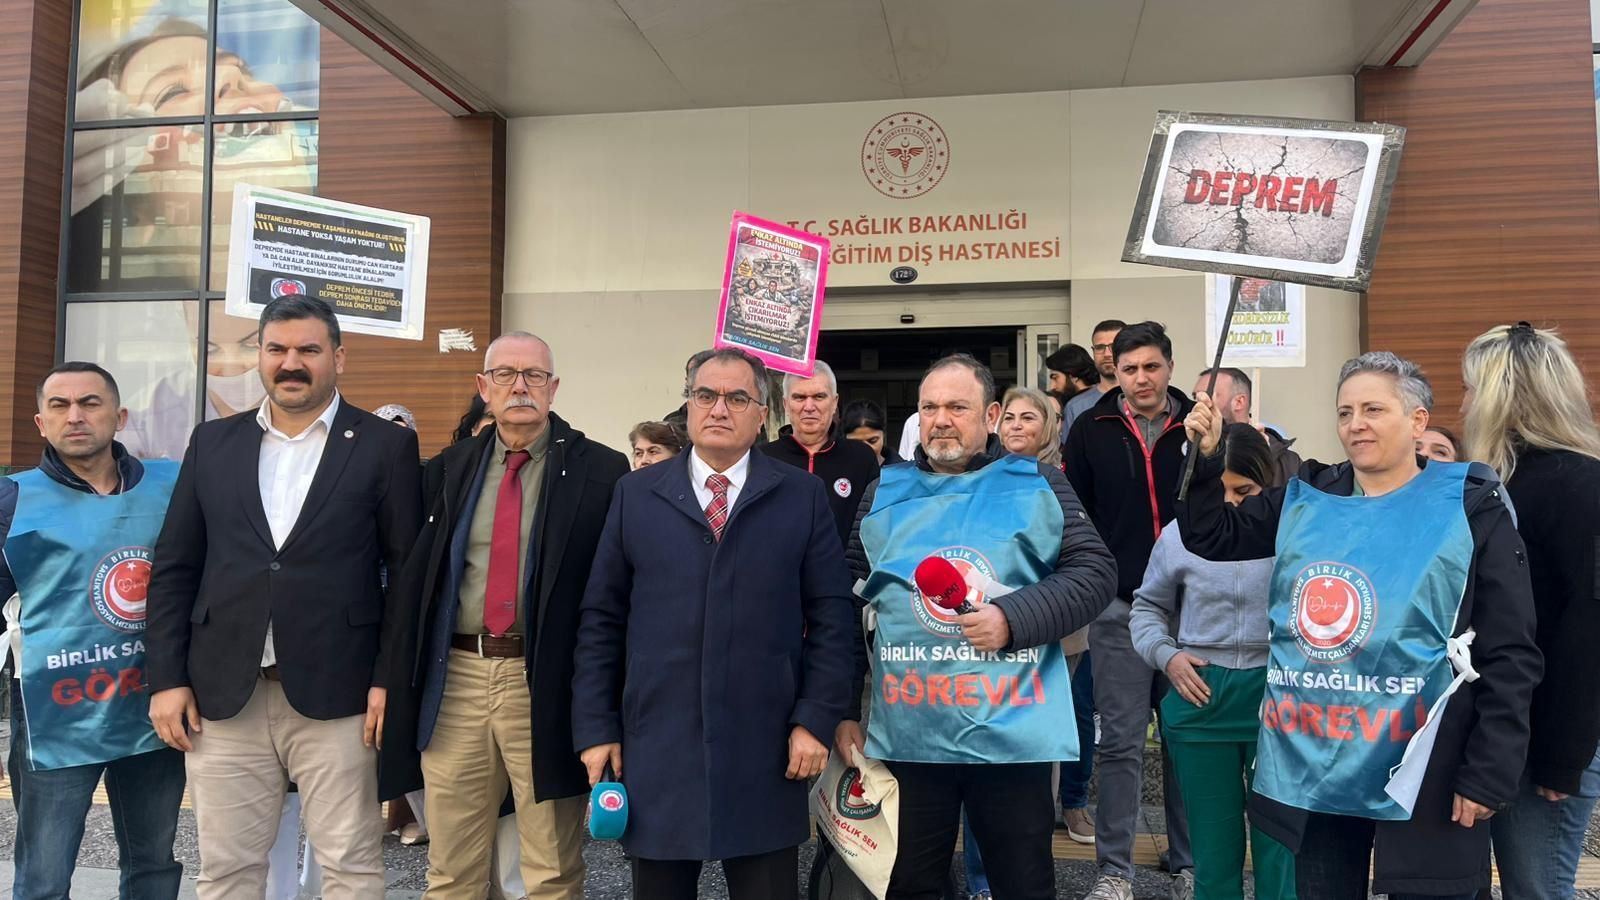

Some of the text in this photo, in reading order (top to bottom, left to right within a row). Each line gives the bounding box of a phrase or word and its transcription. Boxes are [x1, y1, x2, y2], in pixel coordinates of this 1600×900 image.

[1184, 169, 1338, 217] DEPREM
[256, 212, 293, 225] HASTANELER
[293, 218, 322, 230] DEPREMDE
[828, 215, 904, 236] SAĞLIK
[909, 209, 1027, 234] BAKANLIĞI
[278, 225, 386, 249] HASTANE YOKSA YAŞAM YOKTUR!
[750, 229, 803, 250] ENKAZ ALTINDA
[254, 243, 284, 254] DEPREMDE
[284, 247, 310, 258] HASTANE
[310, 251, 345, 263] BİNALARININ
[345, 258, 367, 266] DURUMU
[899, 241, 933, 266] DİŞ
[939, 237, 1061, 261] HASTANESİ
[279, 254, 291, 262] CAN
[291, 256, 305, 265] ALIR.
[306, 259, 338, 269] DAYANIKSIZ
[337, 263, 361, 273] HASTANE
[362, 267, 396, 277] BİNALARININ
[328, 270, 362, 280] SORUMLULUK
[318, 290, 344, 299] DEPREM
[344, 293, 370, 303] SONRASI
[326, 283, 351, 293] DEPREM
[351, 285, 374, 296] ÖNCESİ
[336, 300, 354, 308] DAHA
[745, 298, 792, 314] ENKAZ ALTINDA
[747, 305, 787, 320] ÇIKARILMAK
[744, 313, 790, 329] İSTEMİYORUZ!
[111, 549, 149, 564] BİRLİK
[1308, 565, 1353, 580] BİRLİK
[926, 620, 956, 633] HİZMET
[1327, 622, 1372, 661] ÇALIŞANLARI
[1355, 578, 1372, 621] SENDİKASI
[46, 643, 118, 669] BİRLİK
[880, 641, 1039, 663] BİRLİK SAĞLIK SEN
[882, 668, 1047, 706] GÖREVLİ
[1266, 665, 1299, 688] BİRLİK
[1302, 669, 1381, 693] SAĞLIK
[1263, 694, 1427, 743] GÖREVLİ
[831, 814, 862, 838] SAĞLIK
[862, 834, 878, 850] SEN
